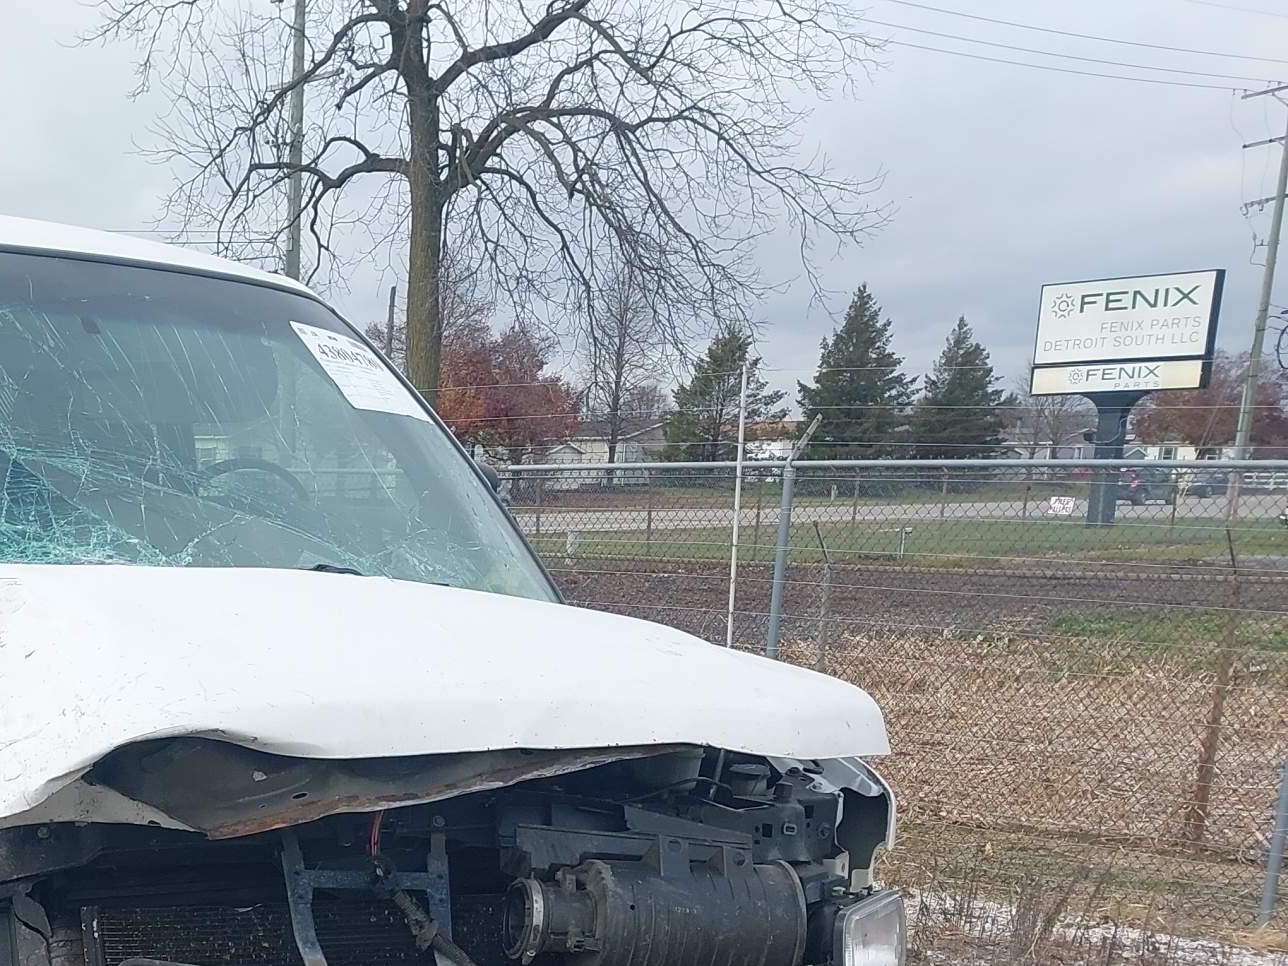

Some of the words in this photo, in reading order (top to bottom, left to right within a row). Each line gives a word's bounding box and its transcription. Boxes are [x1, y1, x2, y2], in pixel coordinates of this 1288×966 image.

[1079, 285, 1201, 314] FENIX
[1100, 319, 1145, 333] FENIX
[1150, 316, 1201, 330] PARTS
[1043, 337, 1107, 352] DETROIT
[1112, 333, 1165, 348] SOUTH
[1171, 331, 1200, 344] LLC
[1085, 365, 1161, 382] FENIX
[1114, 381, 1160, 390] PARTS
